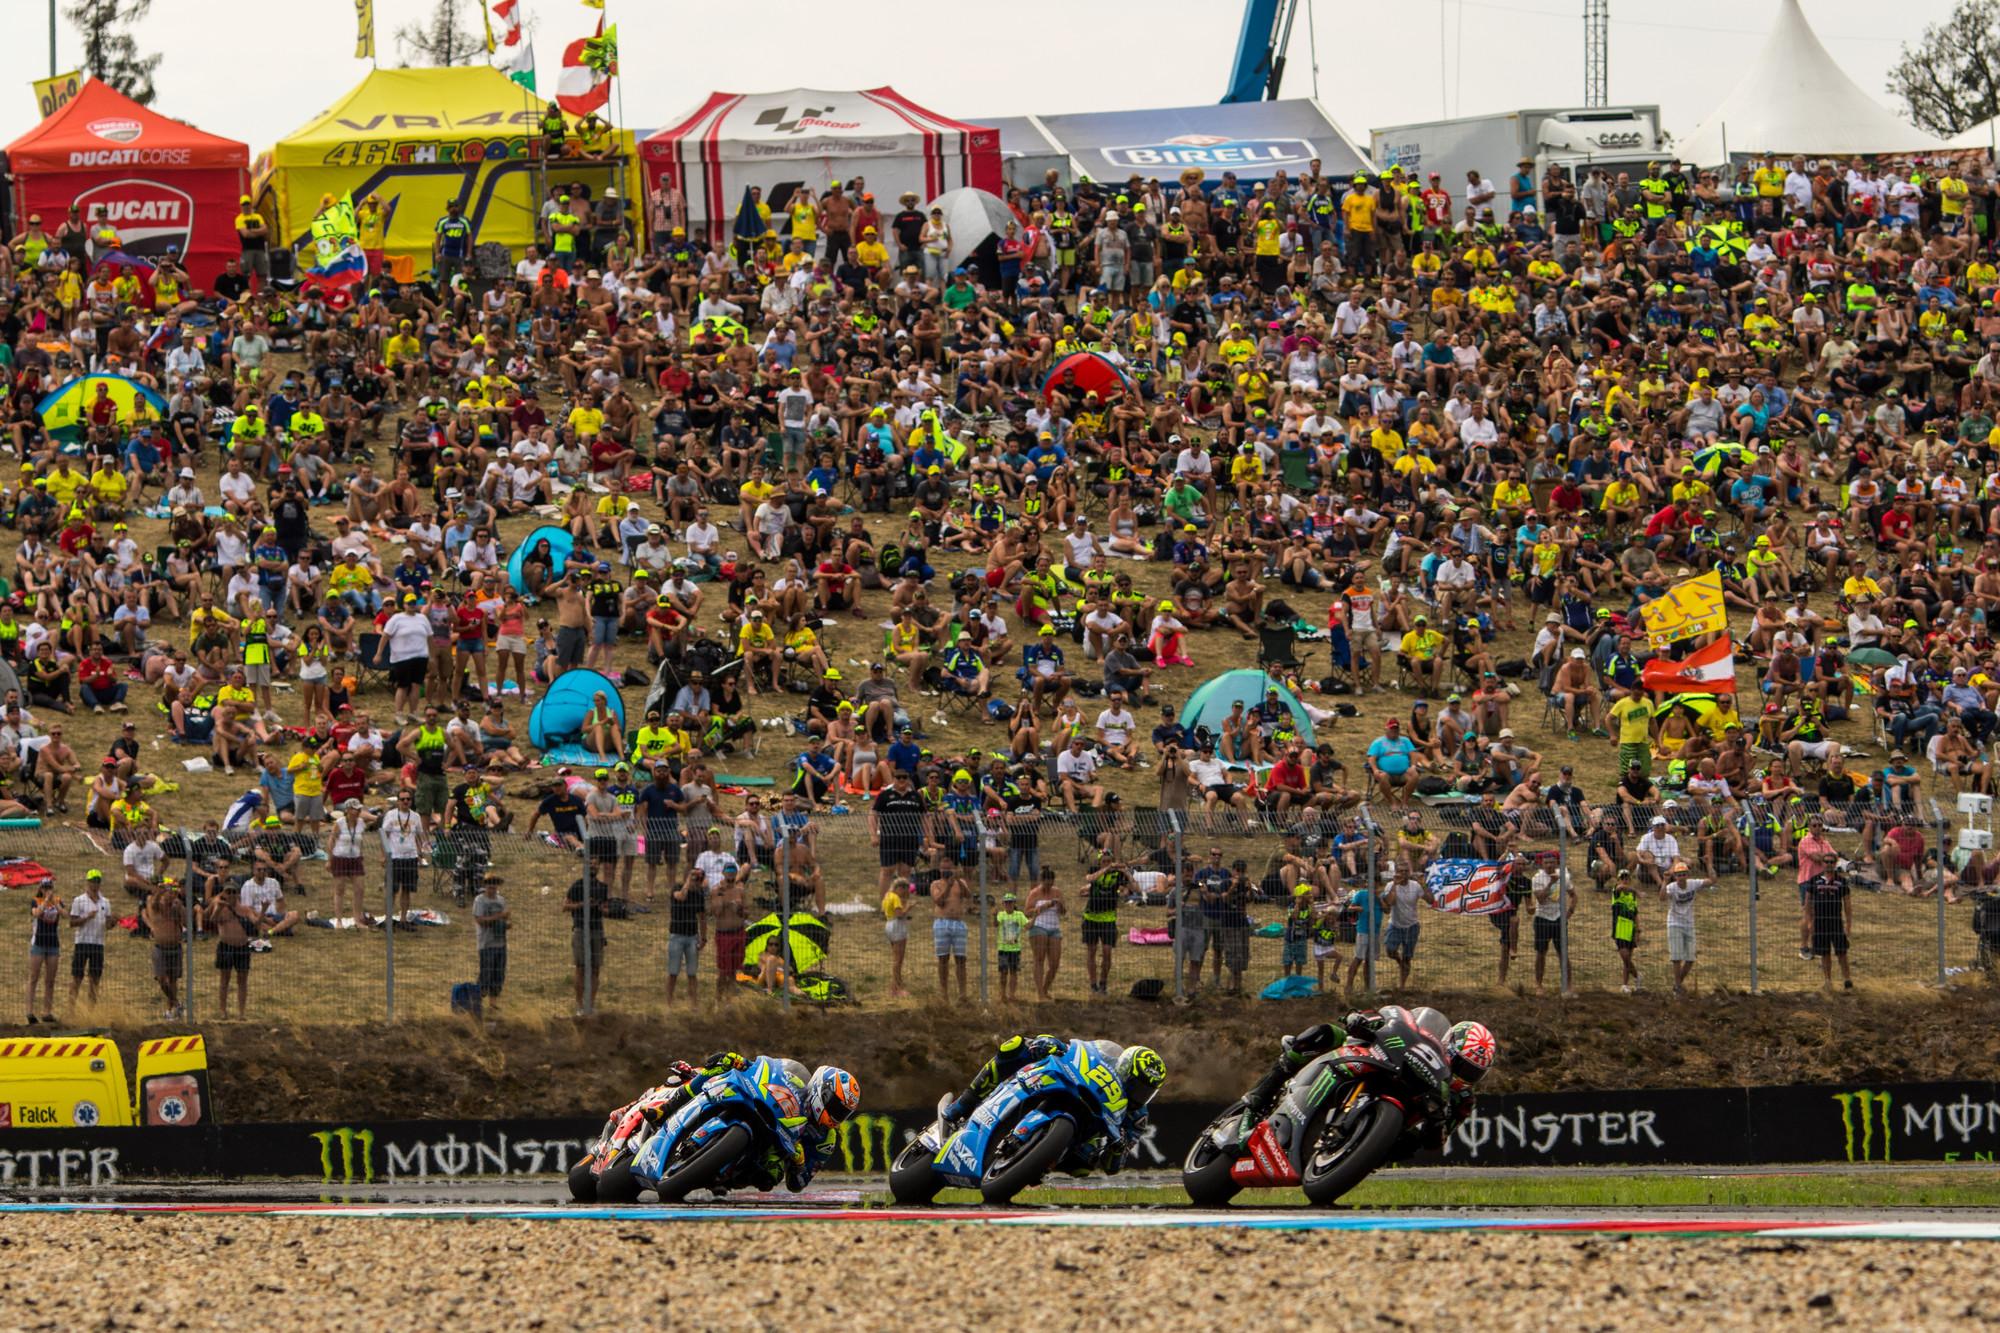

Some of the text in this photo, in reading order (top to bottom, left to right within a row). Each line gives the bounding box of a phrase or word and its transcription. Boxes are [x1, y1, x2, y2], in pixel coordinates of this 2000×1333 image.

[69, 150, 139, 167] DUCATI
[1126, 146, 1299, 164] BIRELL
[87, 201, 180, 221] DUCATI
[299, 423, 317, 432] 46
[647, 739, 665, 749] 46
[616, 793, 636, 804] 46
[1086, 1064, 1123, 1105] 29
[19, 1106, 58, 1124] Falck
[1443, 1105, 1665, 1158] ONSTER
